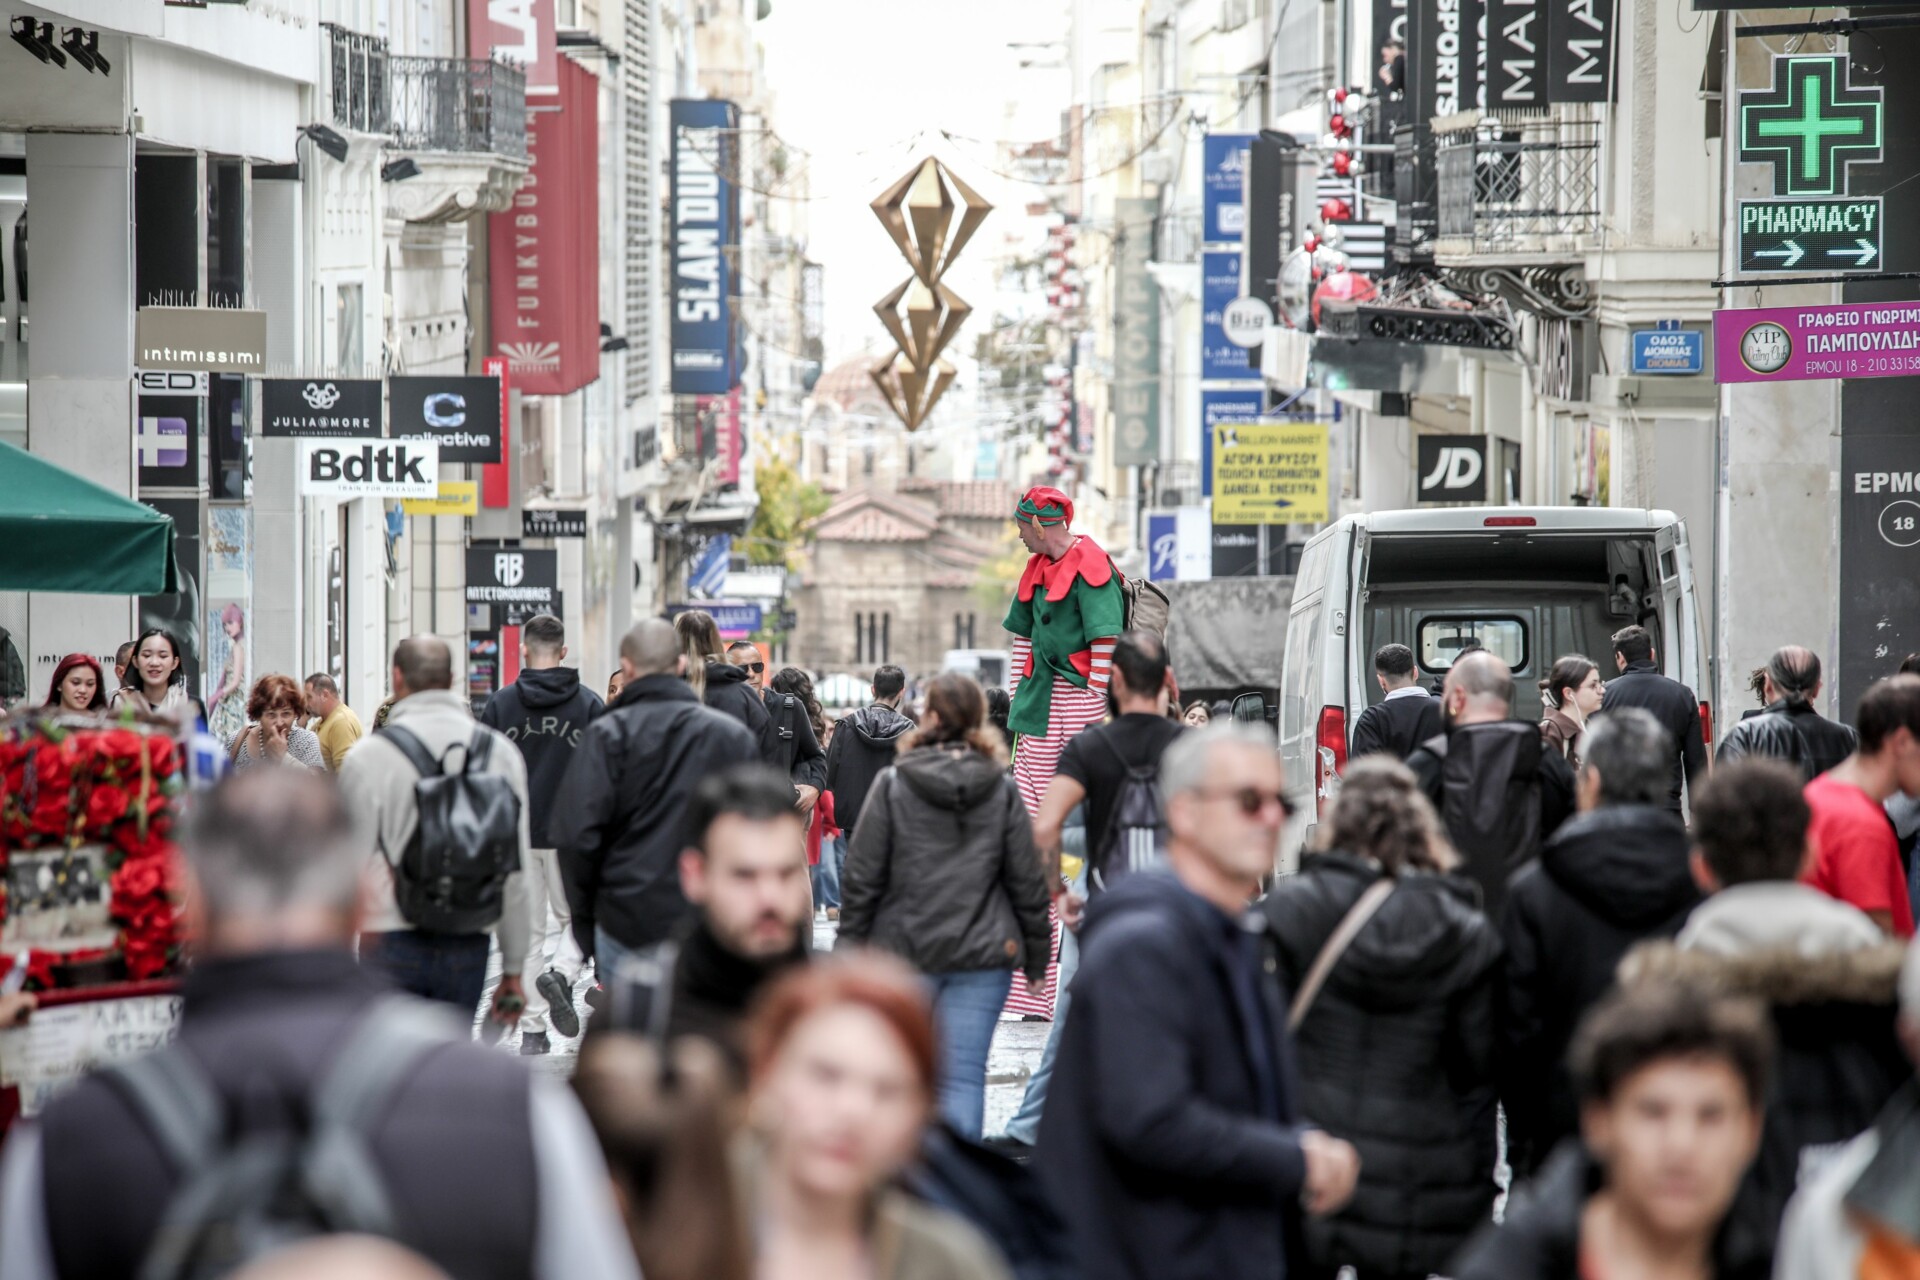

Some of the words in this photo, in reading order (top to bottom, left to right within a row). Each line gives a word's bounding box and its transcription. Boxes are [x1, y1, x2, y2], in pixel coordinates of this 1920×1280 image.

[1502, 0, 1536, 100] MA
[1742, 204, 1876, 234] PHARMACY
[677, 228, 720, 322] SLAM
[1798, 311, 1860, 328] ΓΡΑΦΕΙΟ
[1650, 335, 1686, 345] ΟΔΟΣ
[144, 346, 261, 365] intimissimi
[1643, 346, 1693, 356] ΔΙΟΜΕΙΑΣ
[1646, 358, 1689, 368] DIOMIAS
[1847, 359, 1857, 372] 18
[1868, 357, 1887, 371] 210
[272, 416, 317, 428] JULIA
[330, 417, 370, 428] MORE
[310, 444, 433, 484] Bdtk.
[1422, 447, 1482, 490] JD
[1893, 516, 1915, 531] 18
